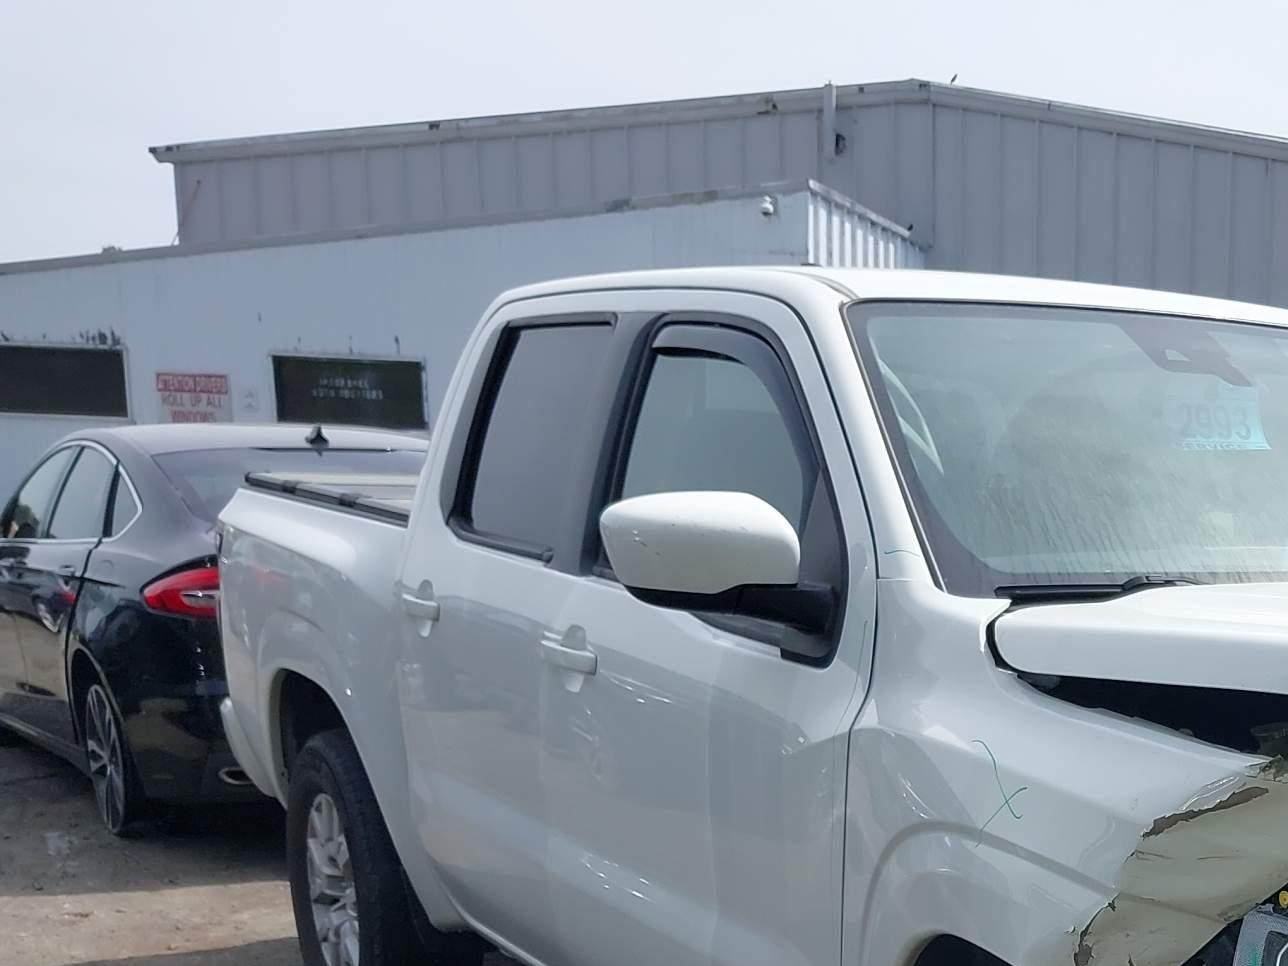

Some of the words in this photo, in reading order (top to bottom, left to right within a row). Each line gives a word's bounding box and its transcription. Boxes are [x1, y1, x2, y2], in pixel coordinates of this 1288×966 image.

[162, 393, 185, 407] ROLL
[190, 393, 202, 407] UP
[207, 393, 223, 408] ALL
